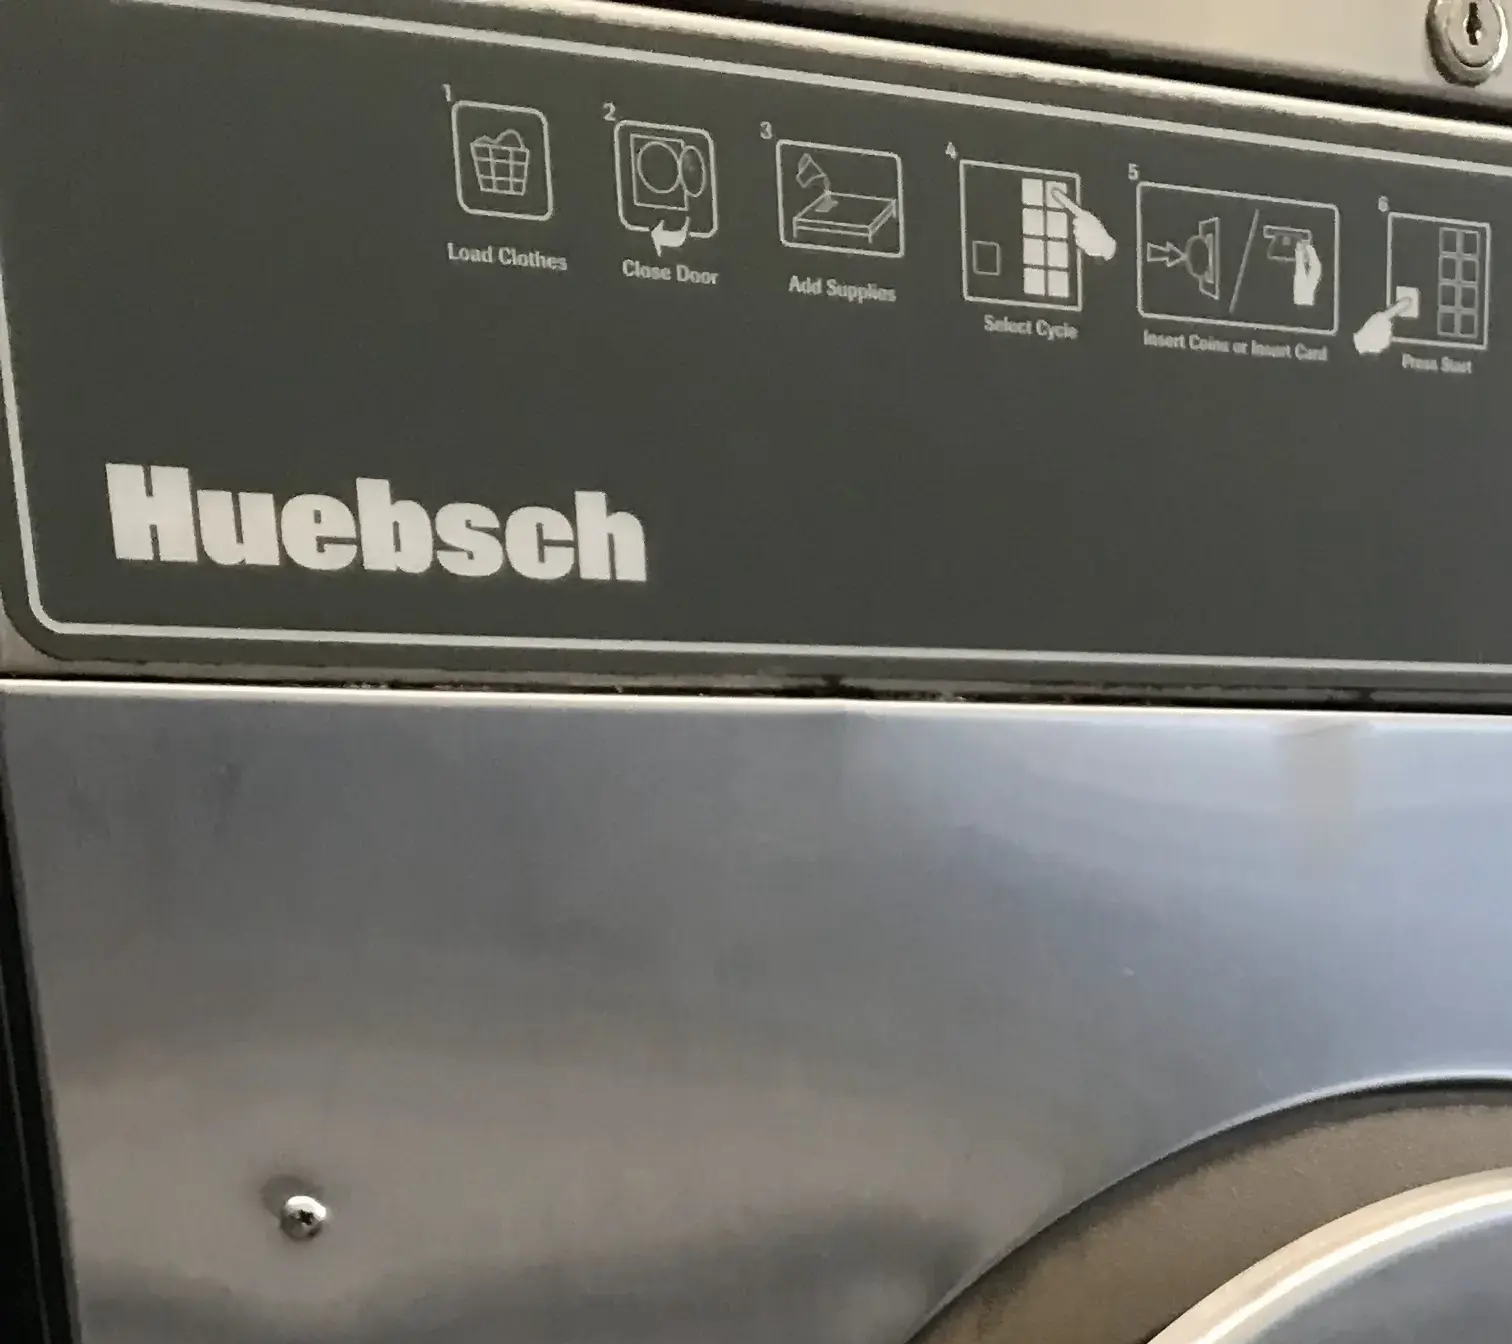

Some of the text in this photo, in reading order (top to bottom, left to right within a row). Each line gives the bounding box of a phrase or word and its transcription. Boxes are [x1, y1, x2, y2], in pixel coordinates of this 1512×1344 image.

[442, 84, 452, 101] 1
[603, 103, 616, 120] 2
[760, 121, 773, 139] 3
[945, 141, 957, 159] 4
[1128, 163, 1139, 181] 5
[448, 242, 567, 270] Load Clothes
[623, 259, 719, 285] Close Door
[789, 275, 896, 304] Add Supplies
[984, 314, 1078, 341] Select Cycle
[1144, 329, 1328, 361] Insert Coins or Insert Card
[1402, 353, 1472, 374] Press Start
[105, 463, 647, 582] Huebsch
